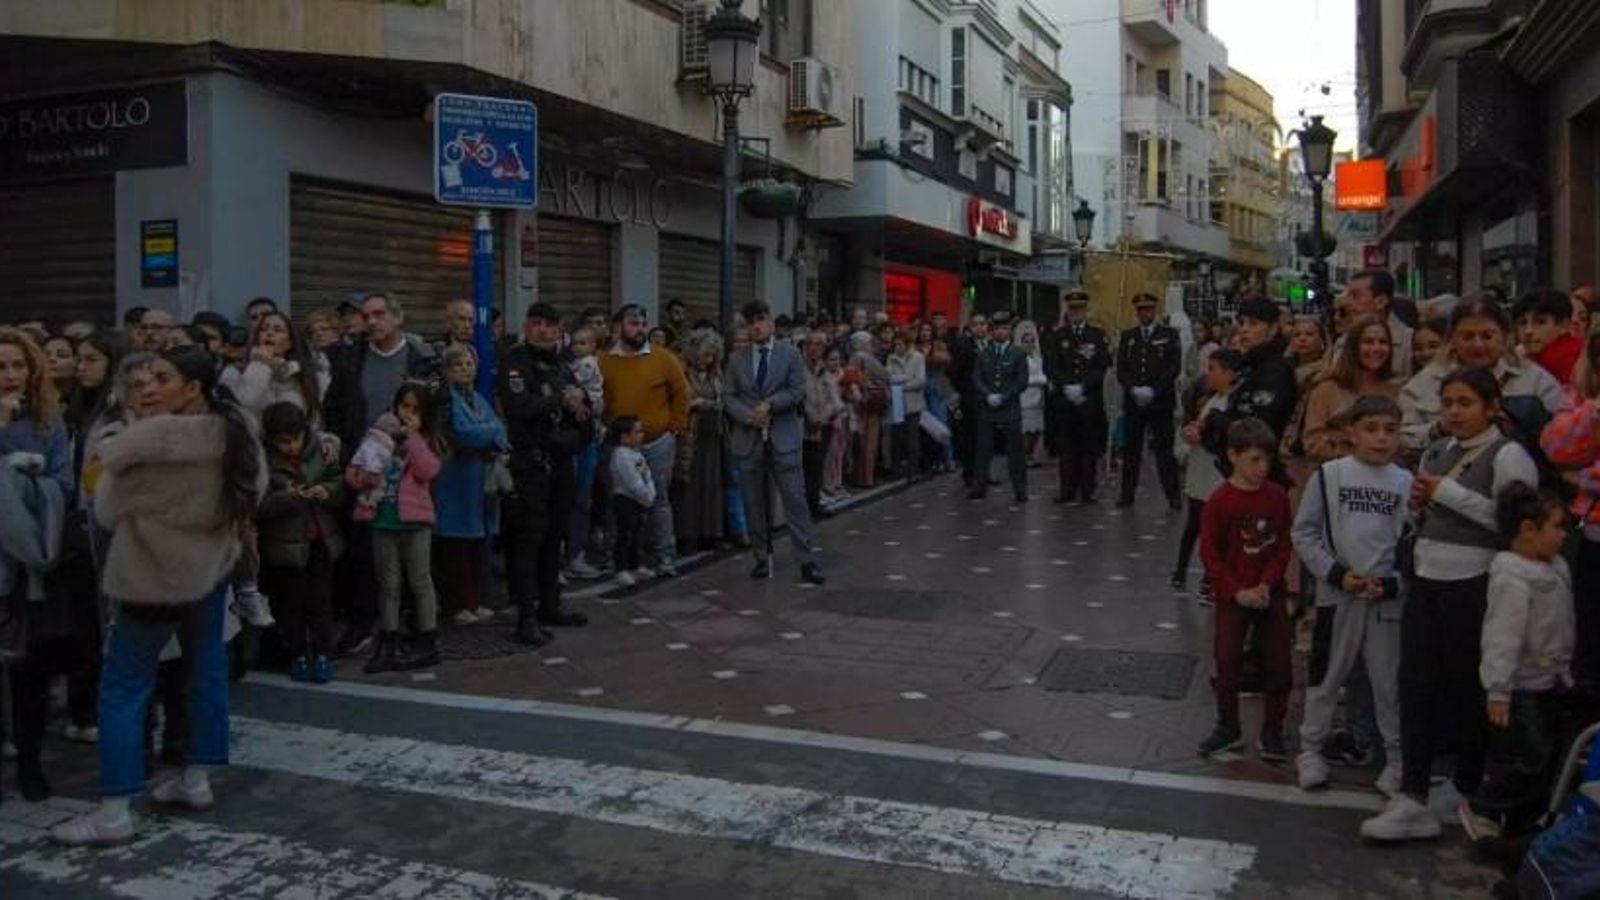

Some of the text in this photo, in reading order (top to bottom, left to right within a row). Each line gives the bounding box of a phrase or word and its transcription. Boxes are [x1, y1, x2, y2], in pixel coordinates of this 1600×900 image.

[18, 97, 151, 137] BARTOLO
[539, 163, 670, 228] ARTOLO
[1337, 195, 1382, 207] orange
[1339, 486, 1401, 509] STRANGER
[1348, 501, 1393, 516] THINGS
